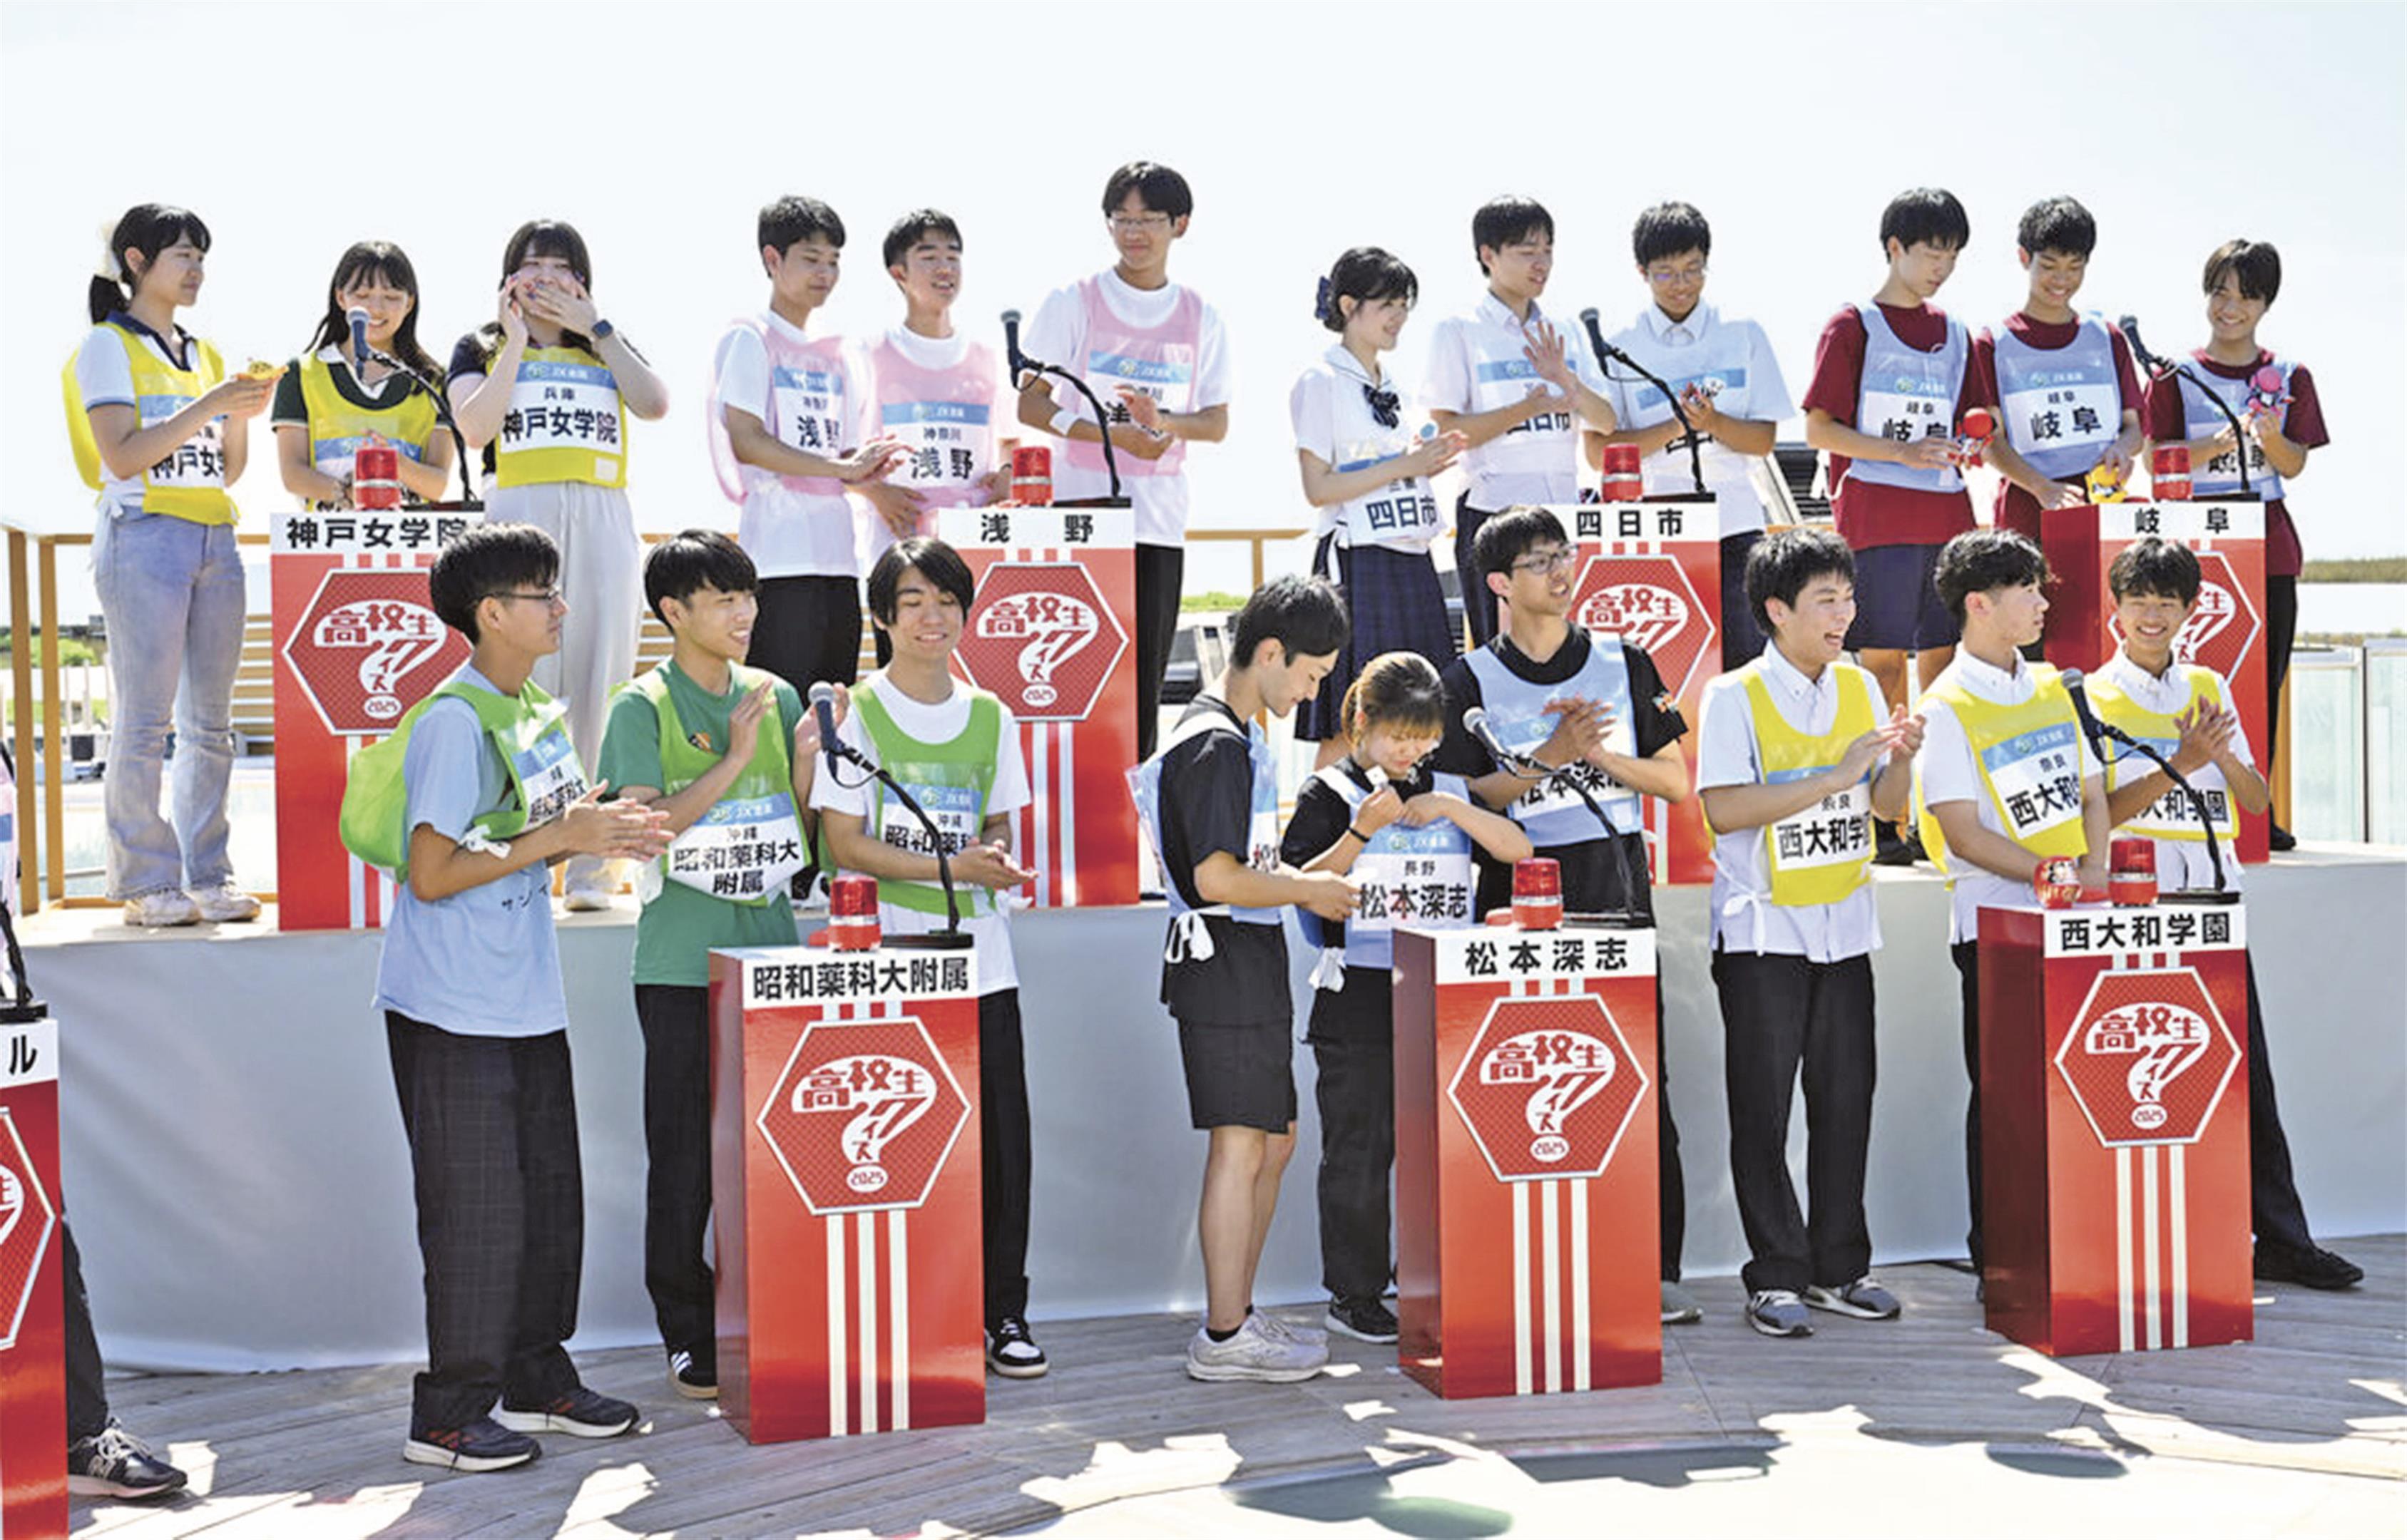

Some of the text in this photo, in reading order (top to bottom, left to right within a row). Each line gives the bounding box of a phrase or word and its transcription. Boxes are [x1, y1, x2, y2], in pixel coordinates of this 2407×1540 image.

[502, 406, 618, 444] 神戸女学院
[2030, 406, 2102, 441] 岐阜
[909, 446, 973, 480] 浅野
[981, 513, 1093, 543] 浅野
[1366, 495, 1437, 530] 四日市
[1576, 508, 1683, 537] 四日市
[2134, 508, 2229, 535] 岐阜
[287, 518, 466, 549] 神戸女学院
[324, 603, 437, 644] 高校生
[986, 596, 1090, 635] 高校生
[1585, 587, 1680, 625] 高校生
[674, 838, 799, 872] 昭和薬科大
[1405, 861, 1436, 876] 長野
[713, 870, 765, 895] 附属
[1359, 883, 1468, 920] 松本深志
[2060, 912, 2230, 951] 西大和学園
[1465, 938, 1627, 976] 松本深志
[753, 957, 969, 1000] 昭和薬科大附属
[2094, 1006, 2201, 1050] 高校生
[9, 1035, 38, 1075] ル
[1489, 1035, 1605, 1081] 高校生
[802, 1059, 926, 1109] 高校生
